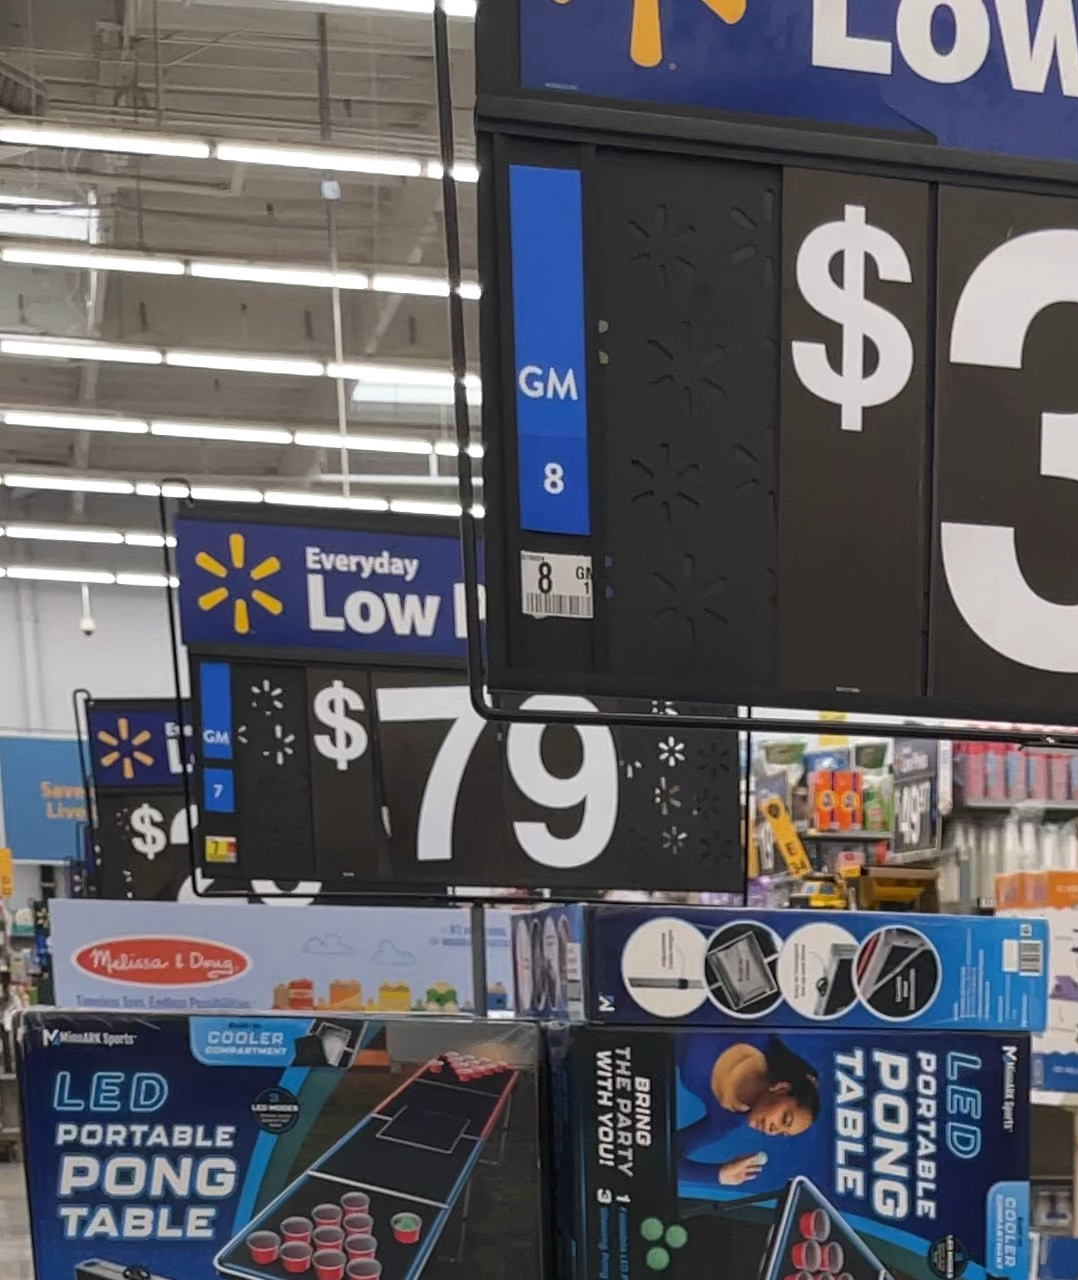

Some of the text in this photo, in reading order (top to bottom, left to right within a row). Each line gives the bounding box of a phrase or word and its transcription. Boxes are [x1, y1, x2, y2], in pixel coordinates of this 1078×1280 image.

[518, 365, 578, 401] GM
[543, 462, 565, 495] 8
[305, 548, 420, 581] Everyday
[538, 562, 552, 594] 8
[307, 582, 440, 636] Low
[203, 730, 230, 746] GM
[213, 784, 224, 798] 7
[89, 947, 236, 979] Melissa & Doug
[207, 1031, 285, 1045] COOLER
[54, 1072, 168, 1112] LED
[595, 1049, 614, 1167] WITH YOU!
[615, 1046, 634, 1177] THE PARTY
[634, 1076, 651, 1146] BRING
[945, 1051, 981, 1159] LED
[55, 1124, 236, 1148] PORTABLE
[835, 1048, 865, 1198] TABLE
[873, 1050, 909, 1219] PONG
[916, 1050, 937, 1219] PORTABLE
[59, 1156, 238, 1196] PONG
[60, 1206, 219, 1240] TABLE
[1004, 1197, 1017, 1268] COOLER
